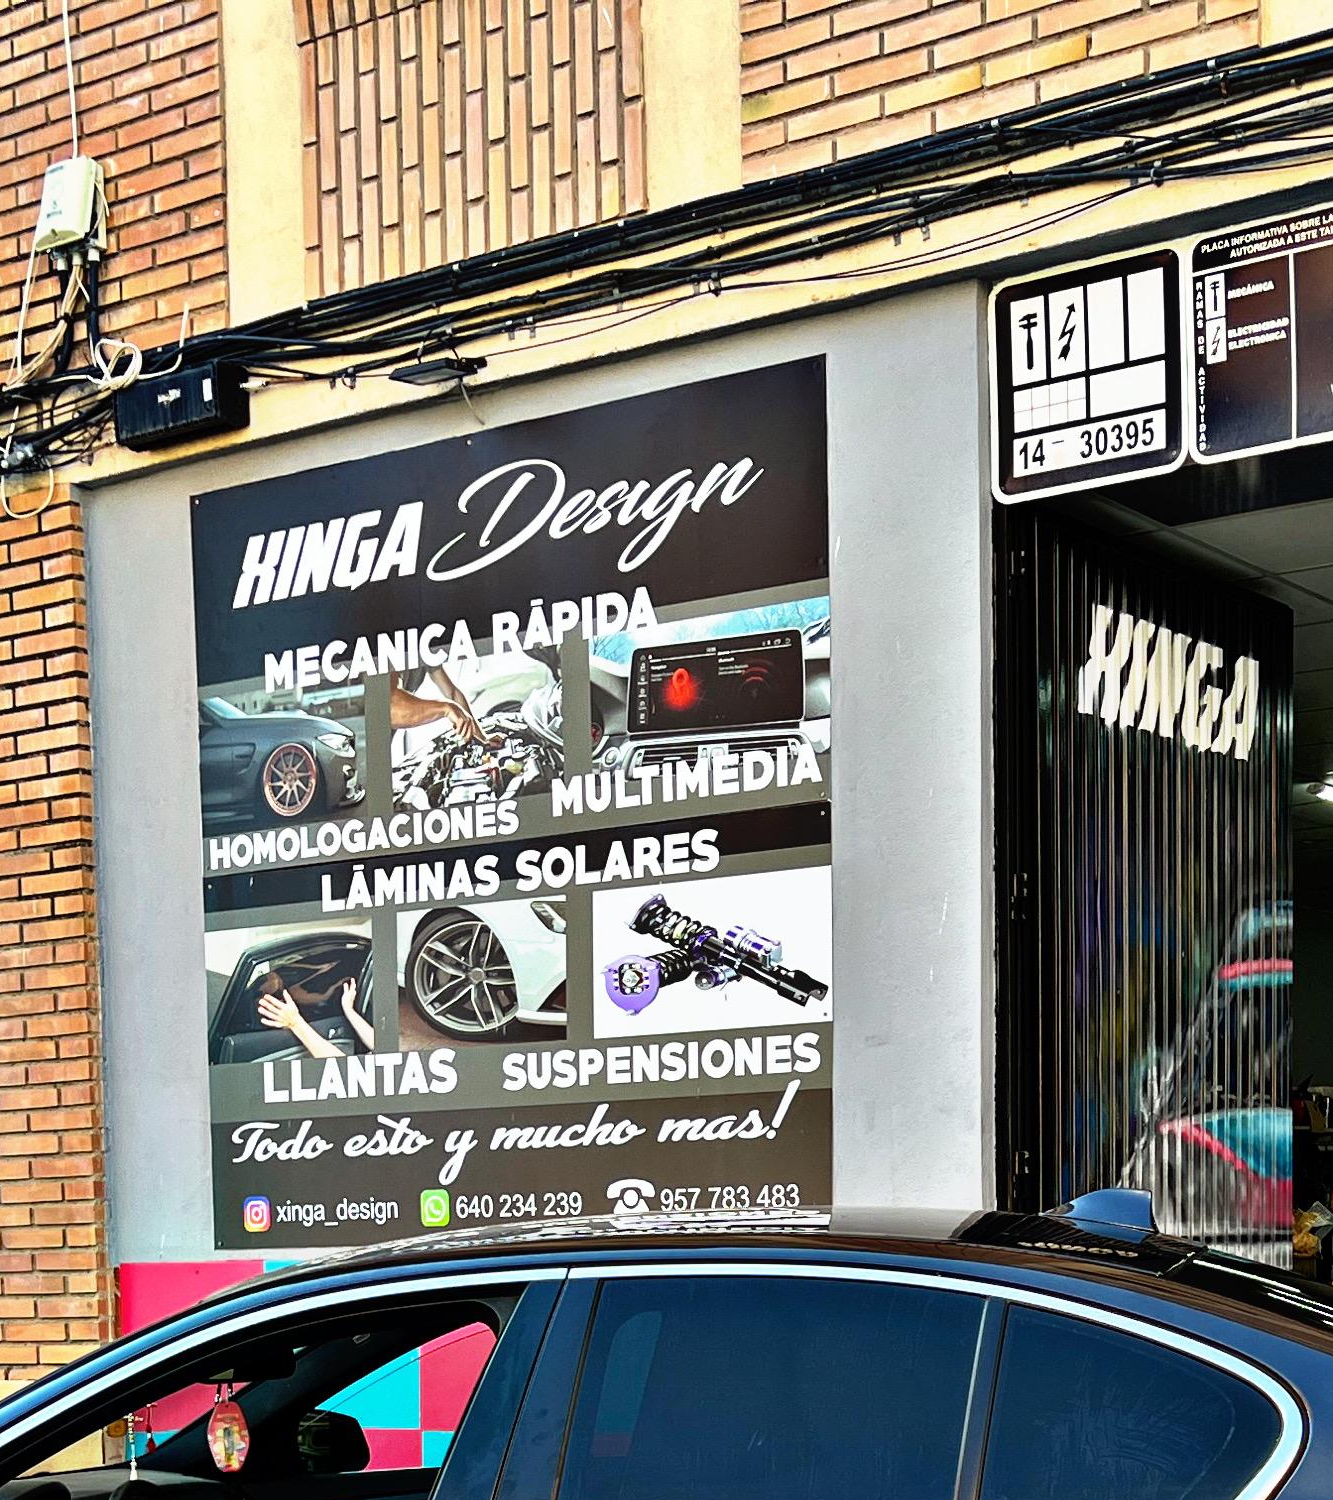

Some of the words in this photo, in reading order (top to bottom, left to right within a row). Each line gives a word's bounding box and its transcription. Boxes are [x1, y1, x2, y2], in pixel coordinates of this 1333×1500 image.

[1200, 236, 1230, 254] PLACA
[1231, 224, 1288, 247] INFORMATIVA
[1289, 217, 1321, 233] SOBRE
[1229, 238, 1285, 259] AUTORIZADA
[1286, 236, 1295, 246] A
[1294, 228, 1319, 243] ESTE
[1018, 438, 1046, 470] 14
[1079, 418, 1155, 460] 30395
[426, 456, 765, 582] Design
[264, 619, 475, 693] MECANICA
[492, 586, 659, 652] RÁPIDA
[551, 743, 822, 818] MULTIMEDIA
[209, 800, 519, 871] HOMOLOGACIONES
[321, 862, 501, 914] LÁMINAS
[515, 828, 720, 893] SOLARES
[264, 1048, 458, 1104] LLANTAS
[502, 1033, 821, 1093] SUSPENSIONES
[231, 1122, 333, 1166] Todo
[344, 1113, 434, 1159] esto
[439, 1136, 477, 1187] y
[489, 1104, 646, 1154] mucho
[657, 1080, 802, 1144] mas!
[275, 1197, 399, 1228] xinga_design
[455, 1195, 495, 1219] 640
[498, 1193, 538, 1218] 234
[542, 1191, 583, 1216] 239
[660, 1188, 701, 1212] 957
[707, 1185, 750, 1210] 783
[756, 1183, 800, 1208] 483
